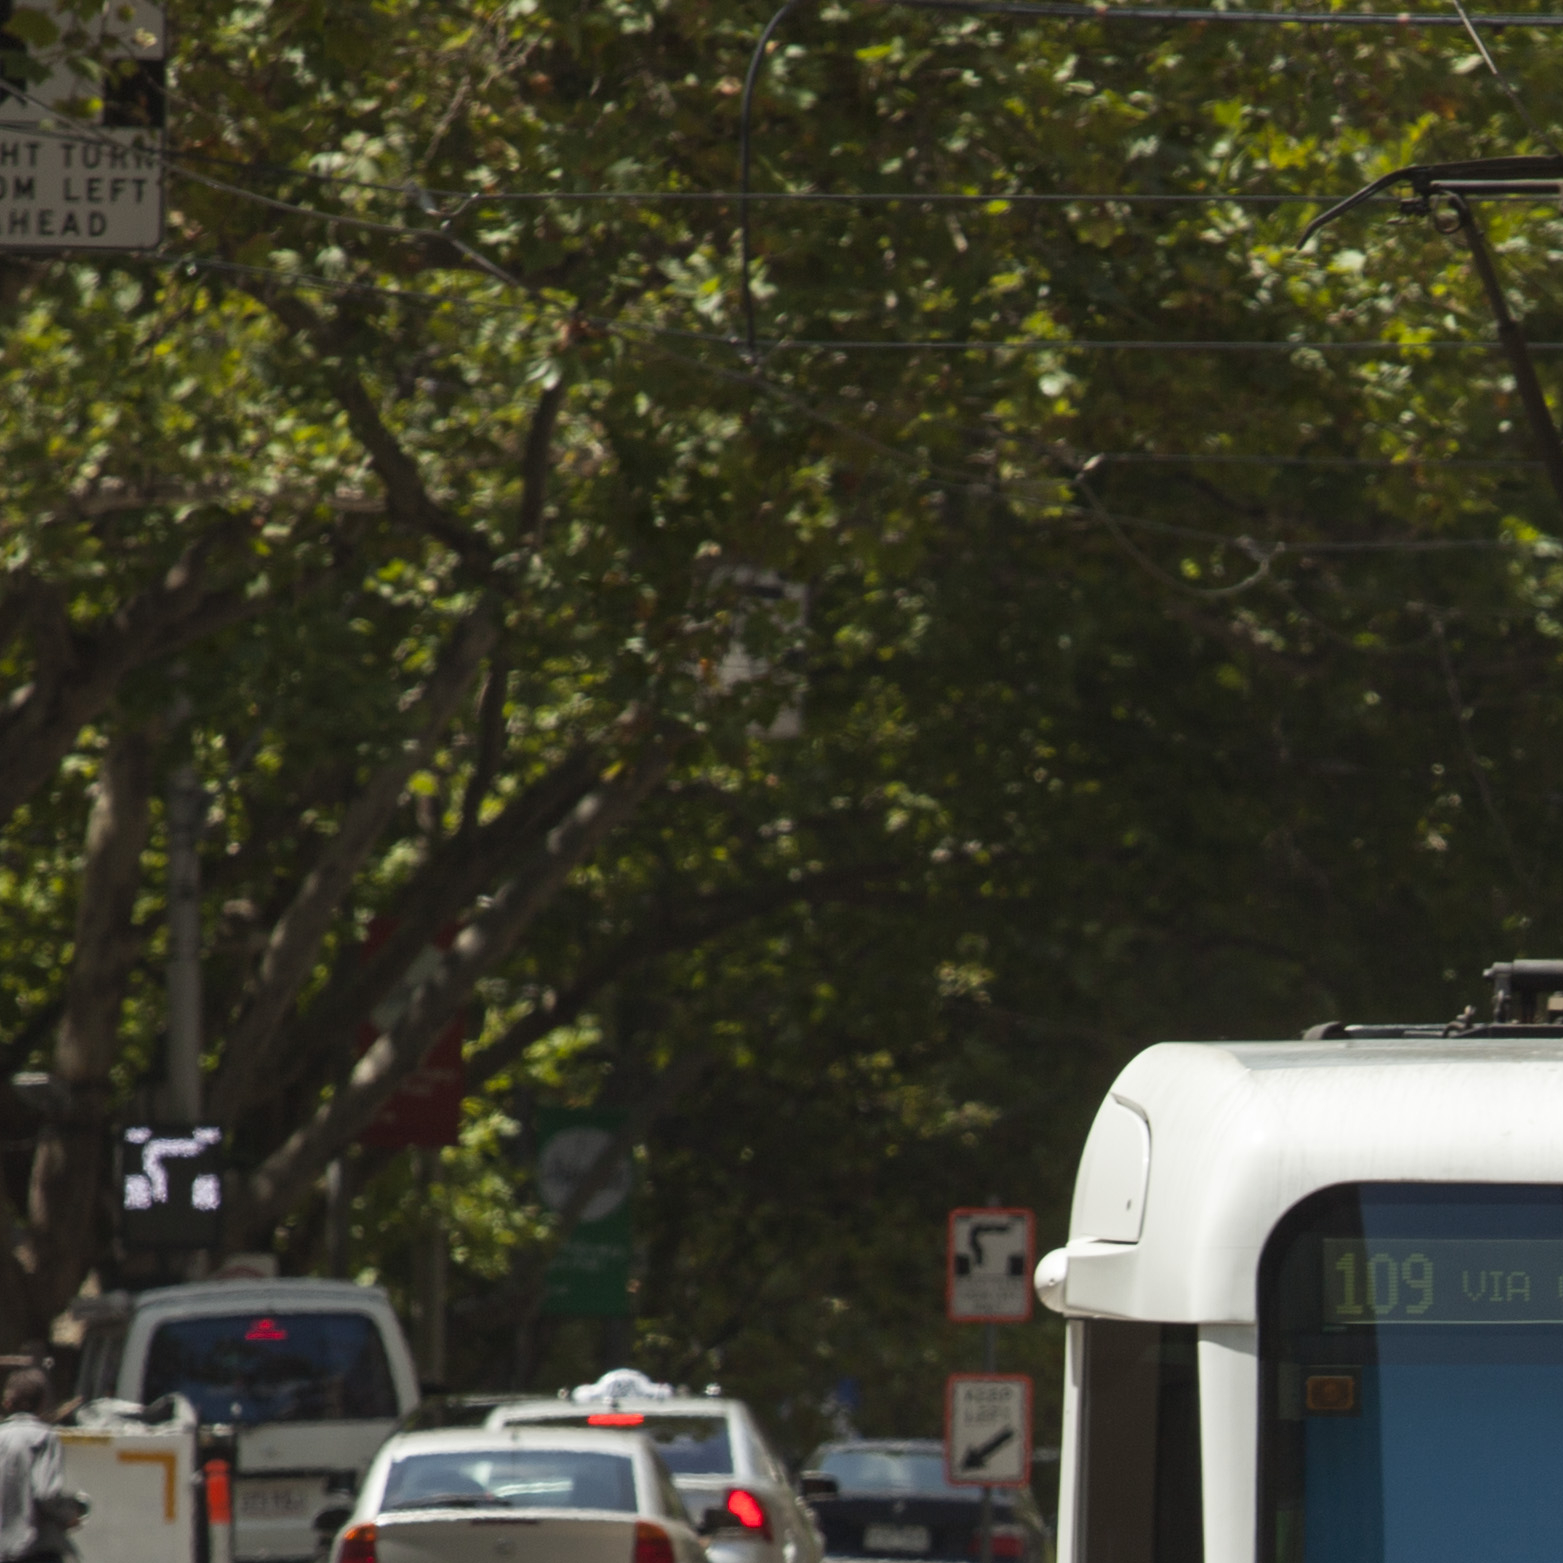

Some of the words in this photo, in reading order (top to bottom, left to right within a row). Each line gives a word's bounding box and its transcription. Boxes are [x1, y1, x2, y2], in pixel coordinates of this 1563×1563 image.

[63, 177, 146, 203] LEFT
[0, 208, 106, 236] HEAD
[1336, 1253, 1433, 1315] 109
[1462, 1271, 1531, 1301] VIA
